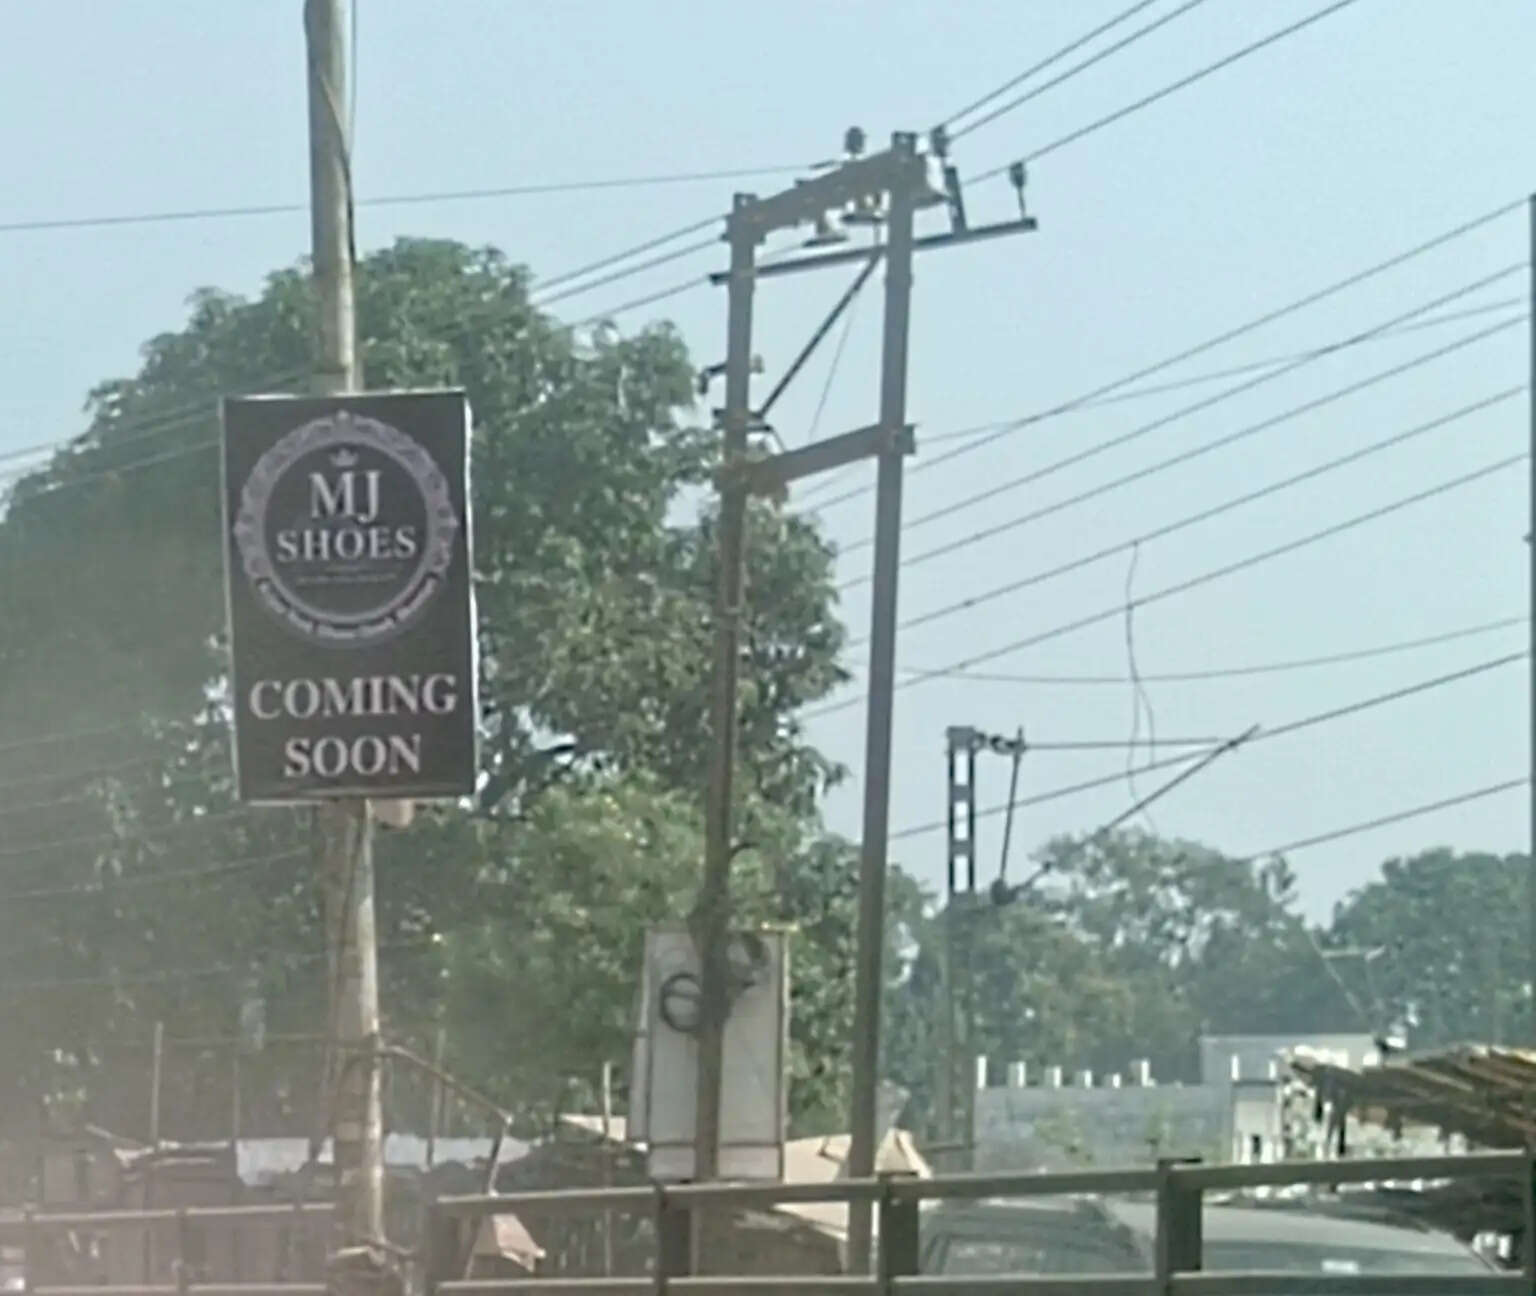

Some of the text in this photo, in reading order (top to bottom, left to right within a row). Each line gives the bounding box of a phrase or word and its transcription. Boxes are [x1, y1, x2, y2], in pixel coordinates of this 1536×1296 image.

[309, 470, 382, 523] MJ
[276, 526, 417, 562] SHOES
[249, 673, 458, 720] COMING
[284, 734, 422, 778] SOON
